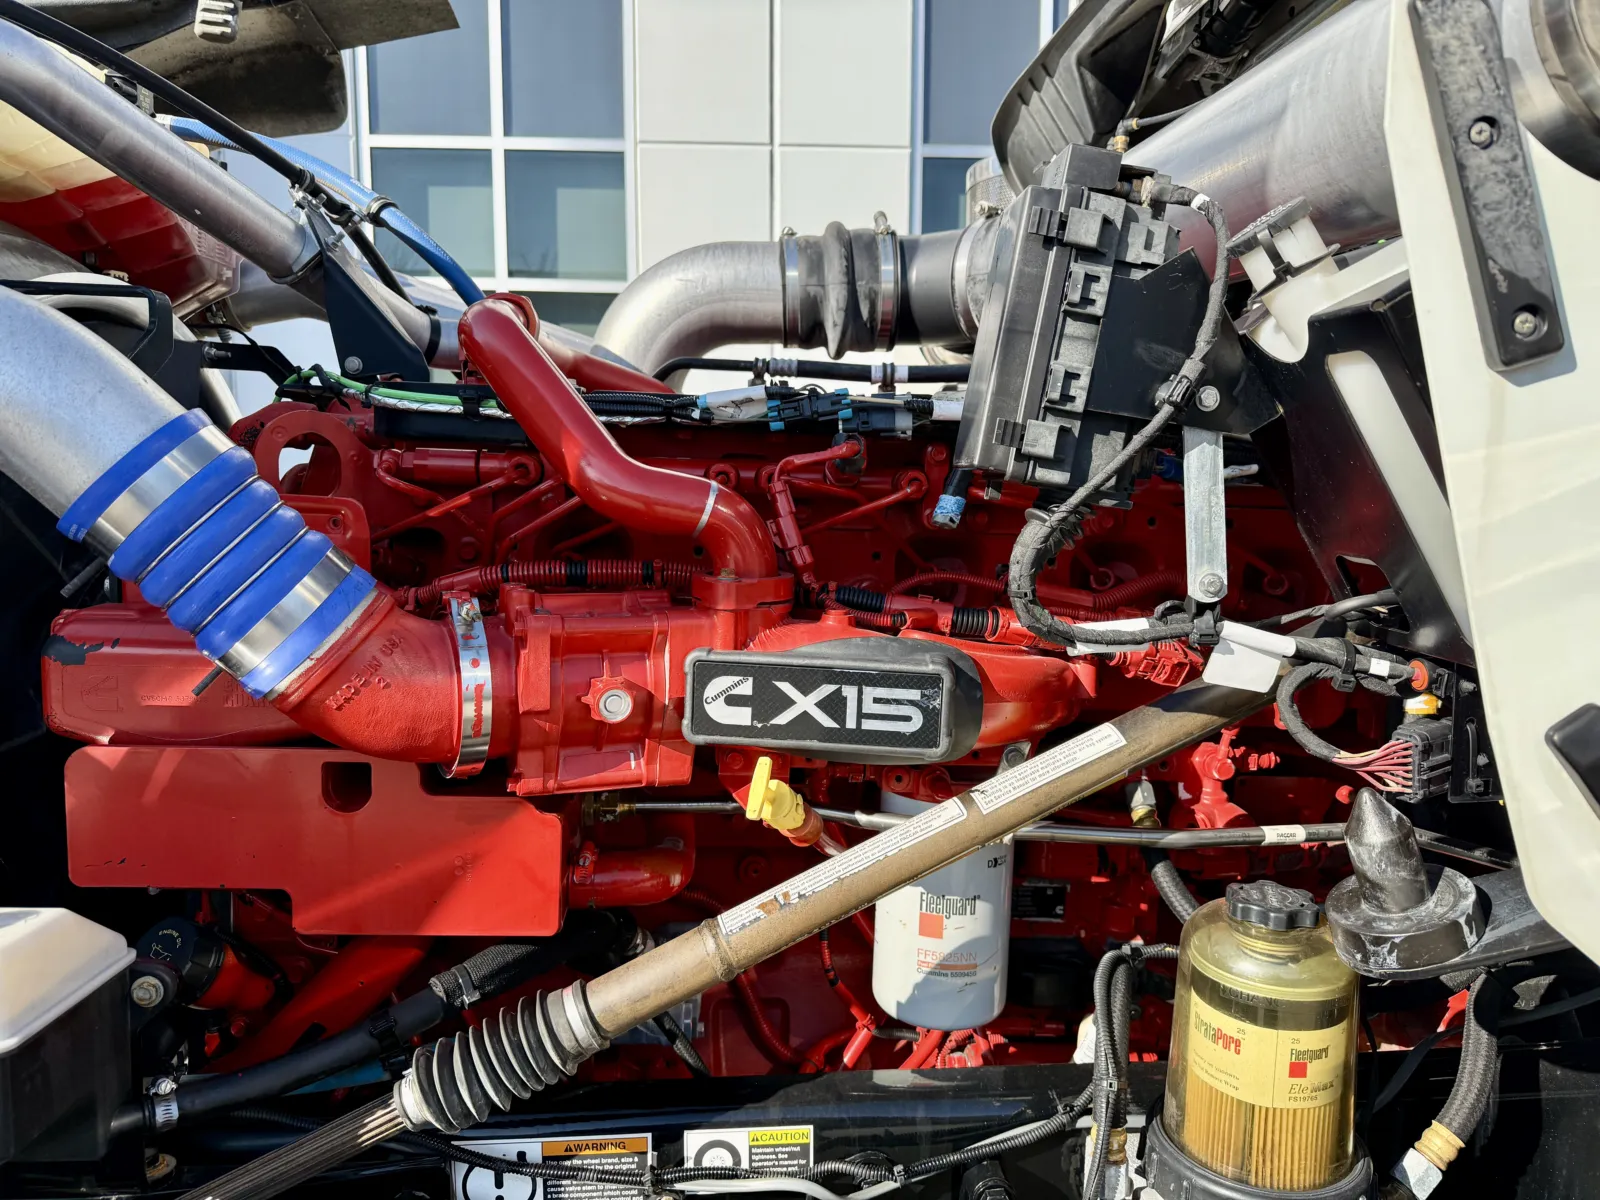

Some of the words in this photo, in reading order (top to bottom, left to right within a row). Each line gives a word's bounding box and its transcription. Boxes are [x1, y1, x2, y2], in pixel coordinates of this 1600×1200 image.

[325, 672, 367, 710] MADE
[364, 656, 384, 679] IN
[376, 676, 389, 690] 2
[703, 675, 750, 706] Cummins
[770, 680, 924, 735] X15
[993, 788, 1012, 800] Service
[1011, 779, 1030, 791] Manual
[1037, 769, 1050, 778] more
[919, 891, 977, 920] Fleetguard
[158, 928, 180, 938] ENGINE
[1290, 1037, 1301, 1045] 25
[1223, 1079, 1240, 1091] Wrap
[760, 1131, 809, 1142] CAUTION
[573, 1141, 627, 1153] WARNING
[558, 1159, 572, 1167] only
[583, 1157, 600, 1165] wheel
[601, 1157, 620, 1165] brand,
[569, 1191, 603, 1199] component
